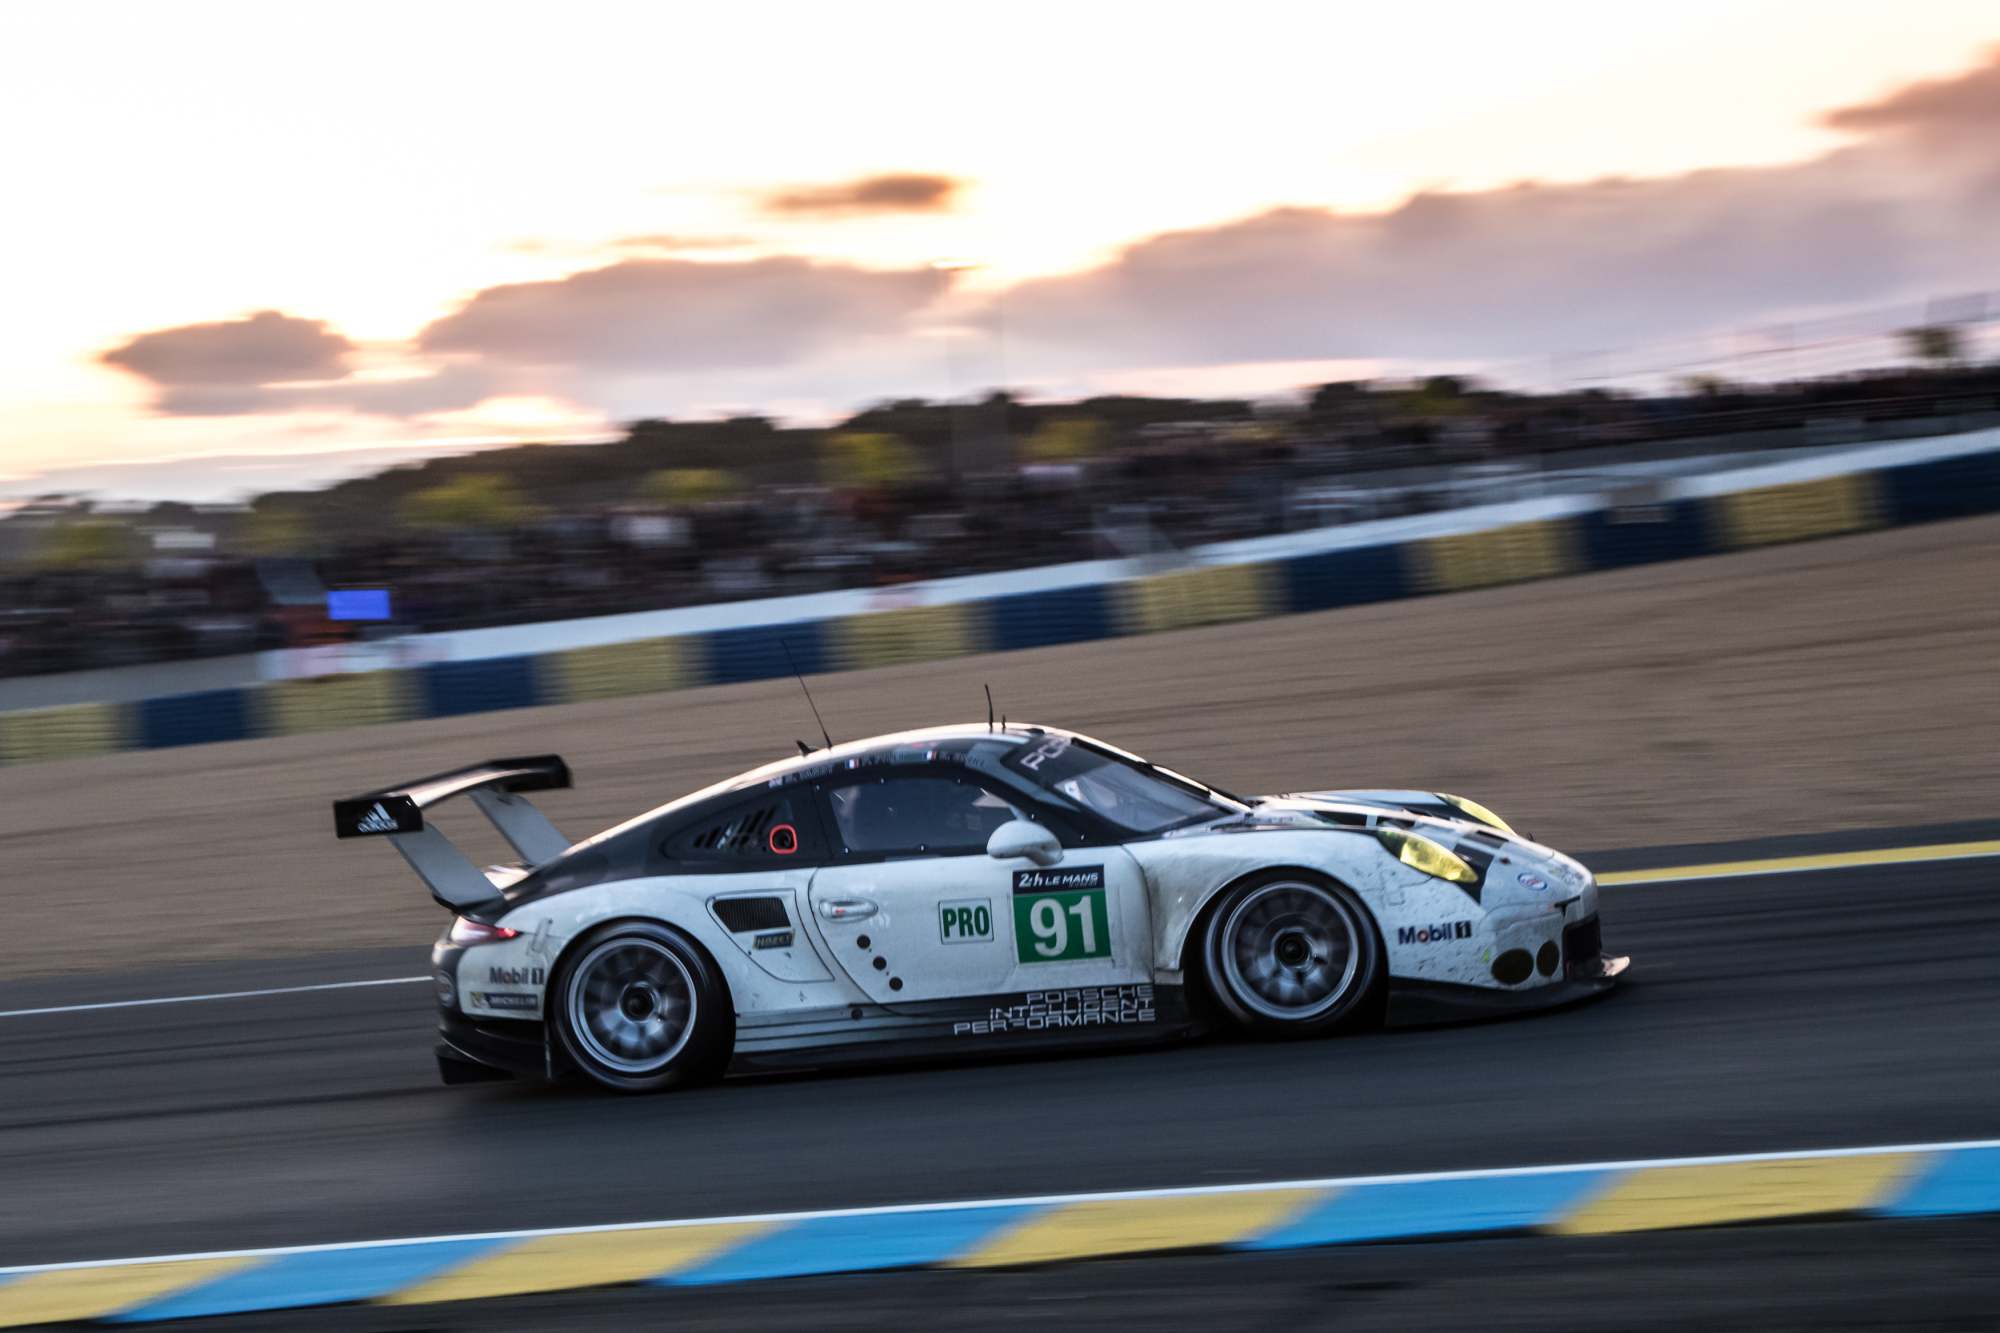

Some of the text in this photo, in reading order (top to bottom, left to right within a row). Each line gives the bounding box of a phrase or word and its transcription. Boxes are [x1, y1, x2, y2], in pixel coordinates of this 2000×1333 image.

[1062, 872, 1099, 884] MANS
[942, 905, 990, 938] PRO
[1029, 894, 1097, 958] 91
[1399, 919, 1472, 944] Mobil 1
[489, 966, 529, 984] Mobil
[1026, 984, 1154, 1004] PORSCHE
[990, 998, 1151, 1020] INTELLIGENT
[953, 1008, 1156, 1036] PERFORMANCE
